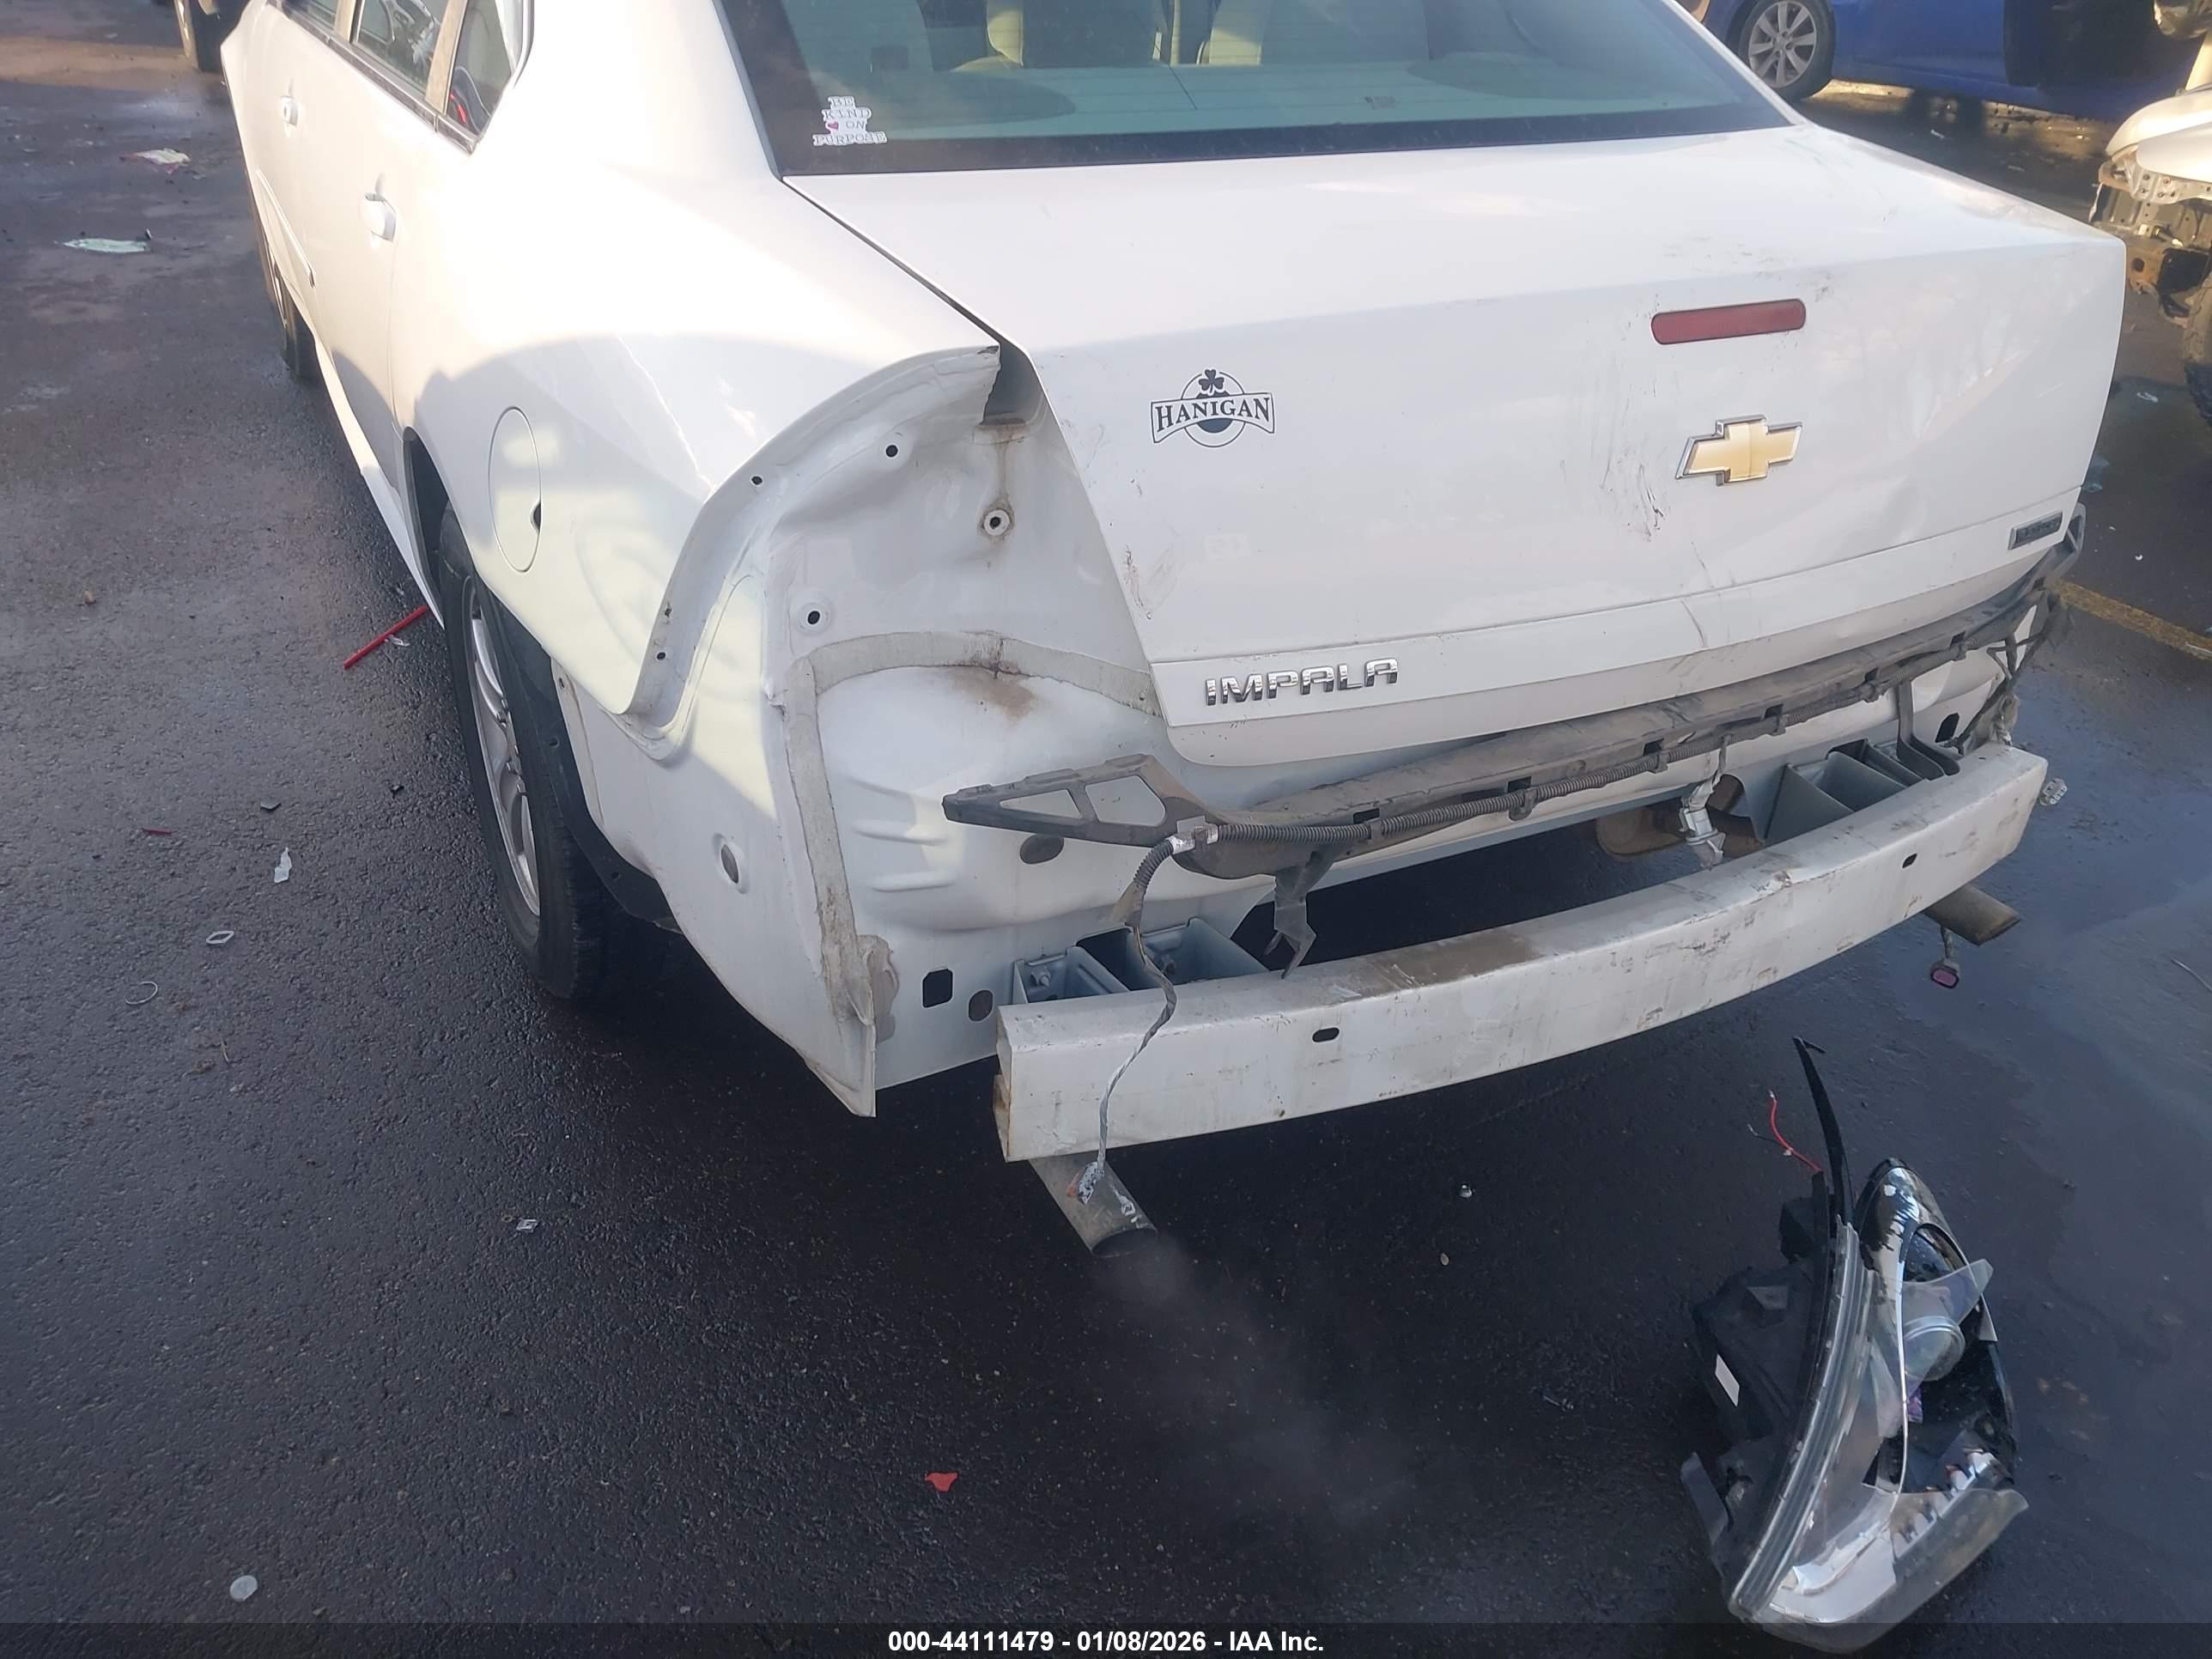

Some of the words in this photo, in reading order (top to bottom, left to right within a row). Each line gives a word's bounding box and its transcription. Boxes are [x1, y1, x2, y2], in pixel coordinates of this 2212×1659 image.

[823, 109, 872, 119] KIND
[845, 121, 866, 130] ON
[813, 131, 887, 145] PURPOSE
[1154, 397, 1271, 434] HANIGAN
[1205, 657, 1399, 706] IMPALA
